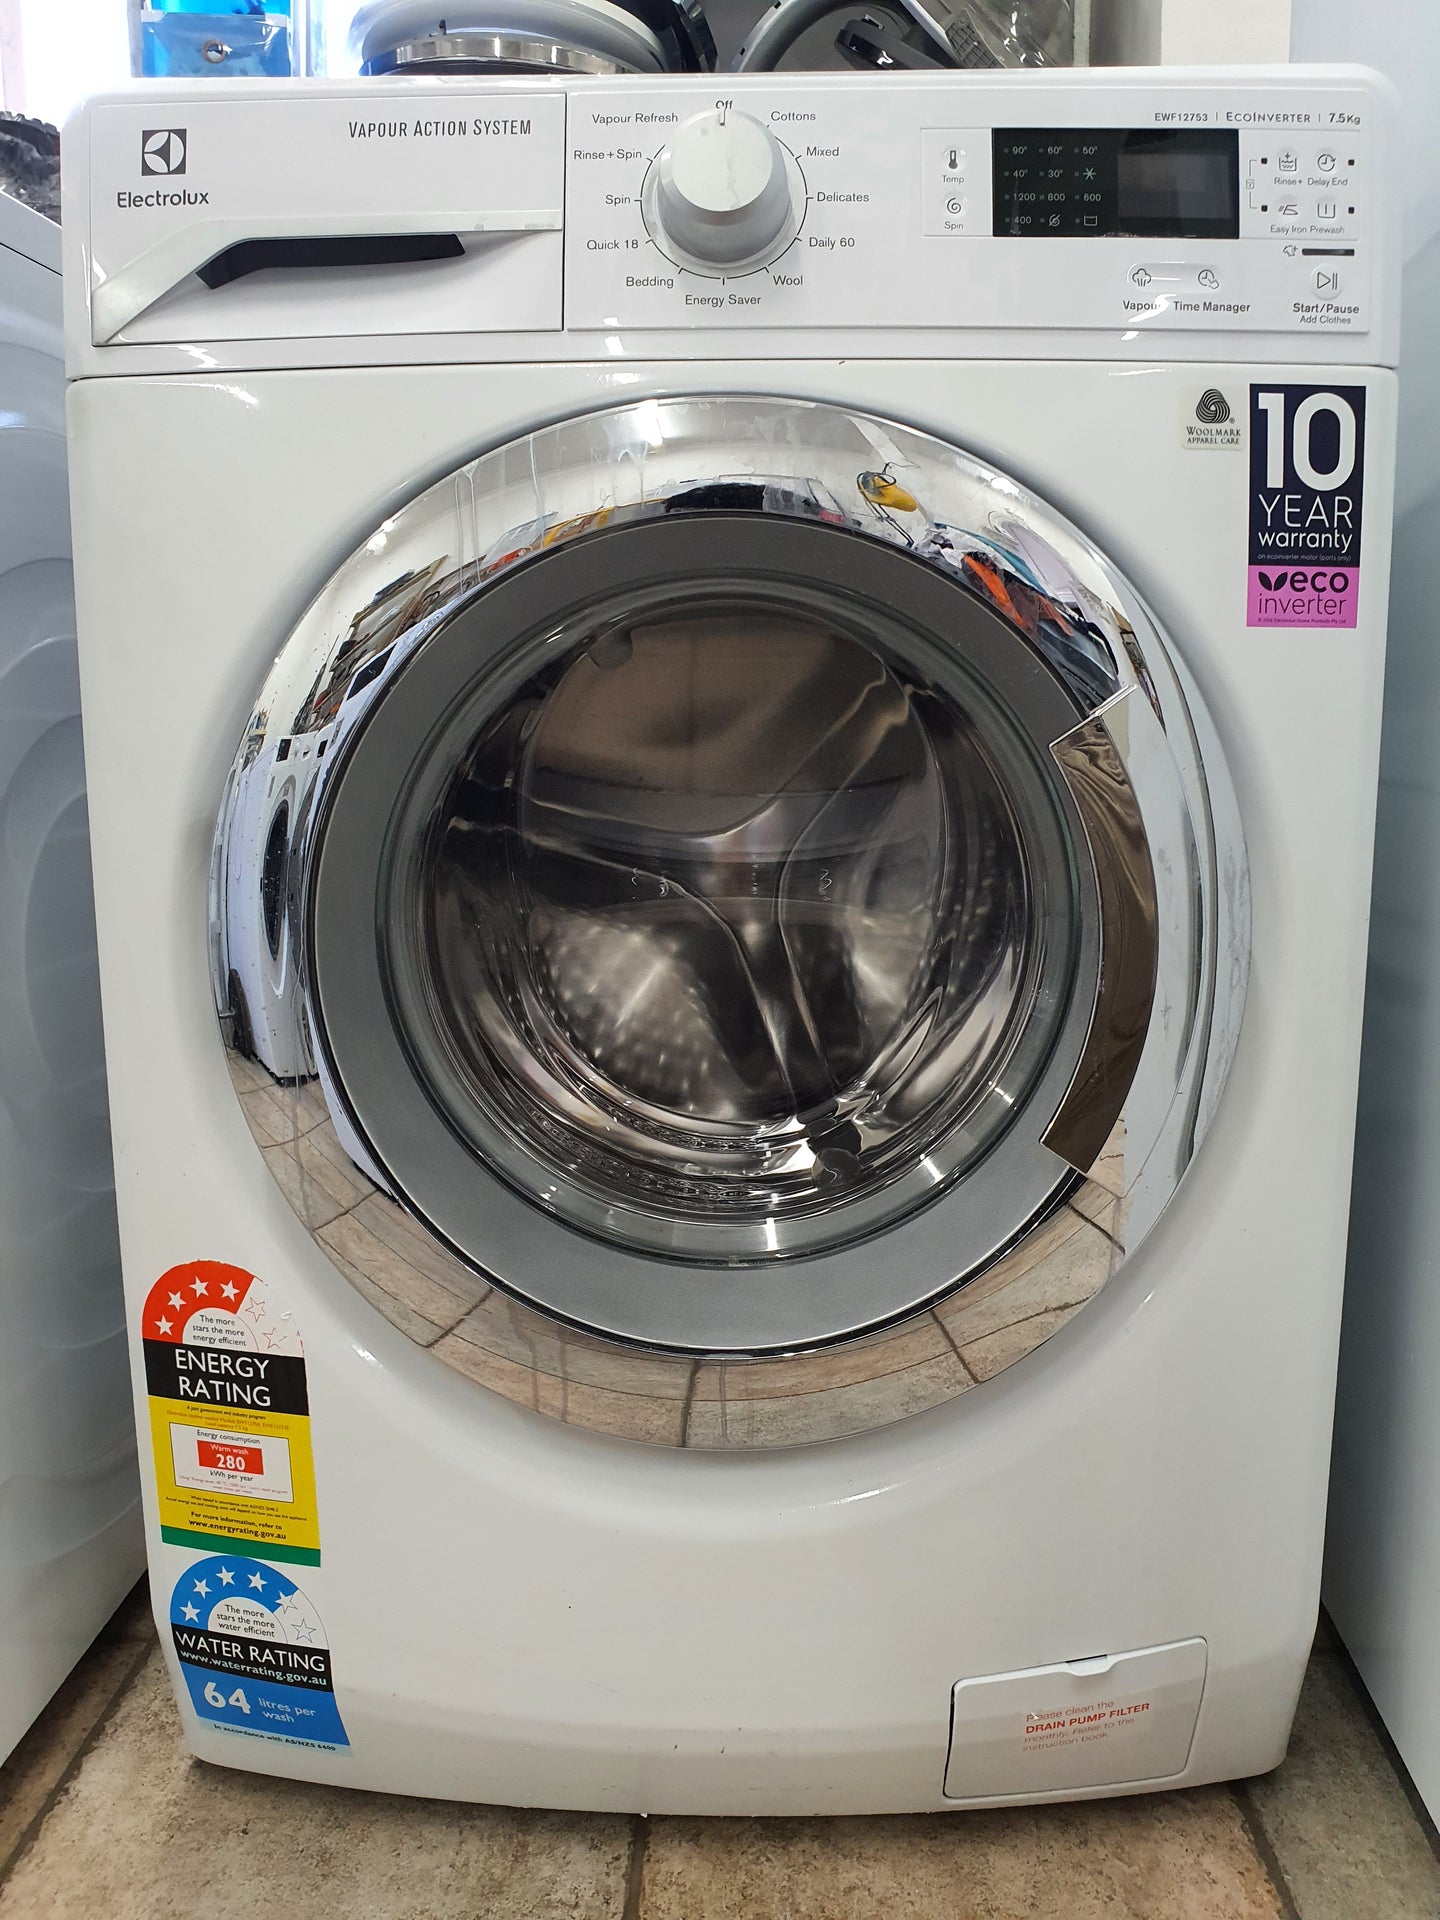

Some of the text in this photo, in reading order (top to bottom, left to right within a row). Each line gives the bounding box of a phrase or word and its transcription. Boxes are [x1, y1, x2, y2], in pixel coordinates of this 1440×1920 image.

[716, 100, 733, 110] Off
[592, 112, 679, 124] Vapour Refresh
[771, 111, 816, 122] Cottons
[1155, 113, 1208, 122] EWF12753
[1328, 113, 1360, 125] 7.5Kg
[806, 147, 840, 157] Mixed
[942, 175, 965, 184] Temp
[1307, 177, 1349, 188] Delay End
[116, 190, 209, 209] Electrolux
[605, 194, 631, 205] Spin
[817, 192, 870, 202] Delicates
[1013, 193, 1036, 201] 1200
[1047, 193, 1066, 201] 800
[1083, 193, 1102, 201] 600
[944, 221, 964, 230] Spin
[1014, 216, 1032, 224] 400
[1270, 225, 1307, 235] Easy Iron
[1310, 226, 1345, 234] Prewash
[586, 239, 639, 251] Quick 18
[809, 237, 855, 249] Daily 60
[626, 276, 674, 289] Bedding
[773, 275, 803, 286] Wool
[685, 295, 761, 308] Energy Saver
[1173, 302, 1251, 314] Time Manager
[1293, 303, 1360, 314] Start/Pause
[1300, 315, 1351, 324] Add Clothes
[1186, 426, 1241, 437] WOOLMARK
[1187, 437, 1218, 445] APPAREL
[1258, 392, 1357, 492] 10
[1258, 494, 1353, 529] YEAR
[1258, 531, 1353, 554] warranty
[1290, 571, 1349, 593] eco
[1258, 593, 1347, 615] inverter
[200, 1314, 235, 1326] The more
[193, 1325, 245, 1337] stars the more
[193, 1335, 247, 1346] energy efficient
[175, 1348, 269, 1379] ENERGY
[178, 1376, 271, 1407] RATING
[197, 1430, 260, 1444] Energy consumption
[210, 1443, 249, 1455] Warm wash
[216, 1454, 246, 1471] 280
[210, 1470, 254, 1483] kWh per year
[203, 1513, 219, 1521] more
[220, 1515, 257, 1527] information,
[259, 1521, 274, 1529] refer
[189, 1519, 287, 1540] www.energyrating.gov.au
[225, 1604, 265, 1618] The more
[216, 1613, 275, 1629] stars the more
[218, 1622, 275, 1638] water efficient
[175, 1630, 326, 1672] WATER RATING
[180, 1650, 327, 1686] www.waterrating.gov.au
[203, 1681, 251, 1714] 64
[258, 1697, 316, 1717] litres per
[1065, 1704, 1094, 1716] clean
[1097, 1700, 1114, 1710] the
[263, 1710, 295, 1723] wash
[1025, 1702, 1150, 1734] DRAIN PUMP FILTER
[1072, 1724, 1101, 1735] Refer
[1104, 1721, 1115, 1729] to
[1117, 1717, 1135, 1727] the
[222, 1726, 264, 1739] accordance
[266, 1734, 283, 1743] with
[1022, 1737, 1078, 1751] instruction
